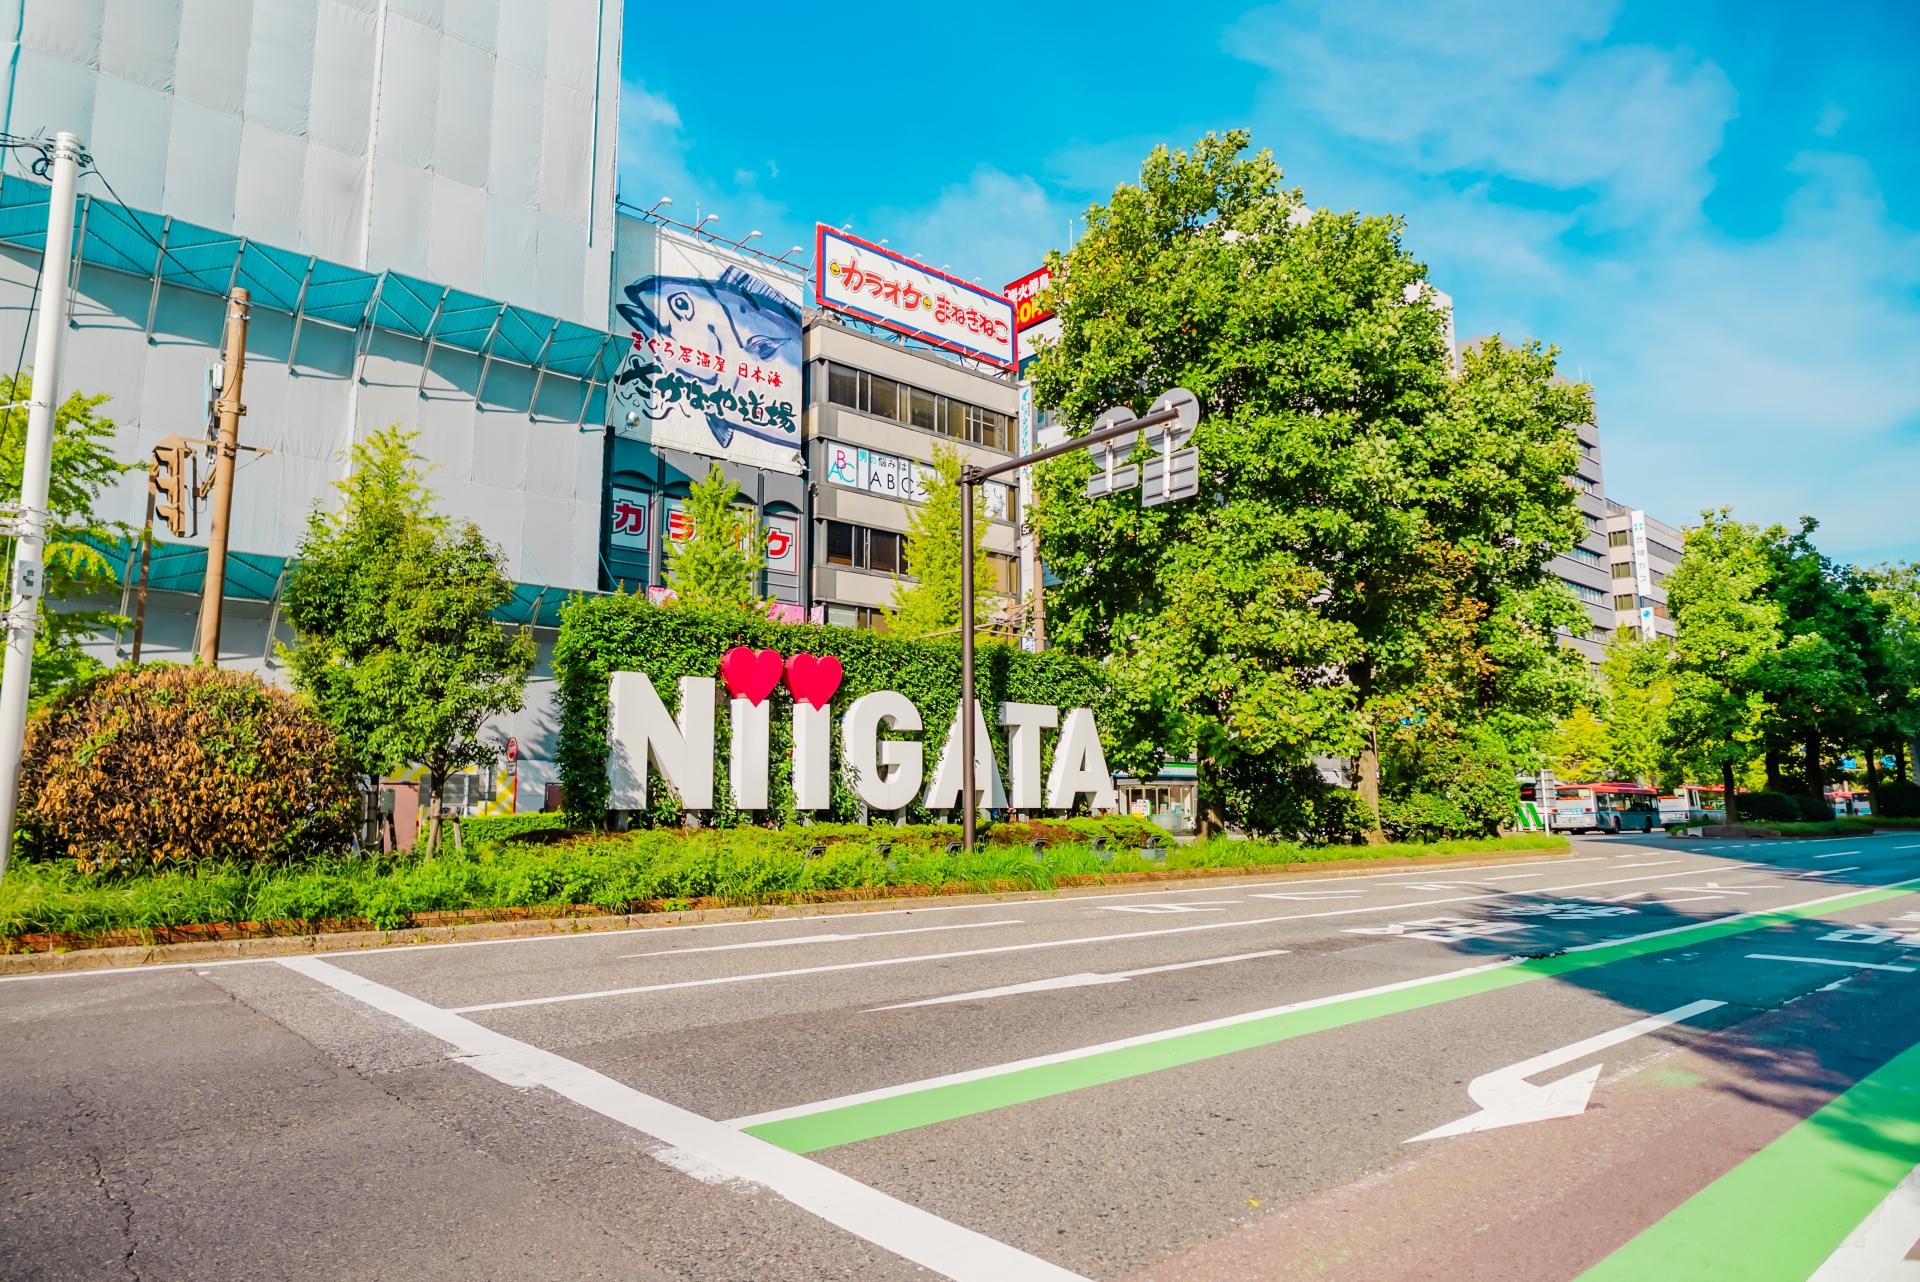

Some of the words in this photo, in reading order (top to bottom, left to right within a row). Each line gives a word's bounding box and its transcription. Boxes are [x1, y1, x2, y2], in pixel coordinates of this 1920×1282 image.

[841, 257, 922, 309] カラオケ
[934, 294, 1009, 343] まねきねこ
[631, 331, 727, 373] まぐろ居酒屋
[737, 362, 783, 388] 日本海
[615, 358, 797, 434] さかなや道場
[859, 450, 907, 472] 男の悩みは
[1635, 535, 1648, 583] 北陸ガス
[607, 671, 1116, 811] NIIGATA
